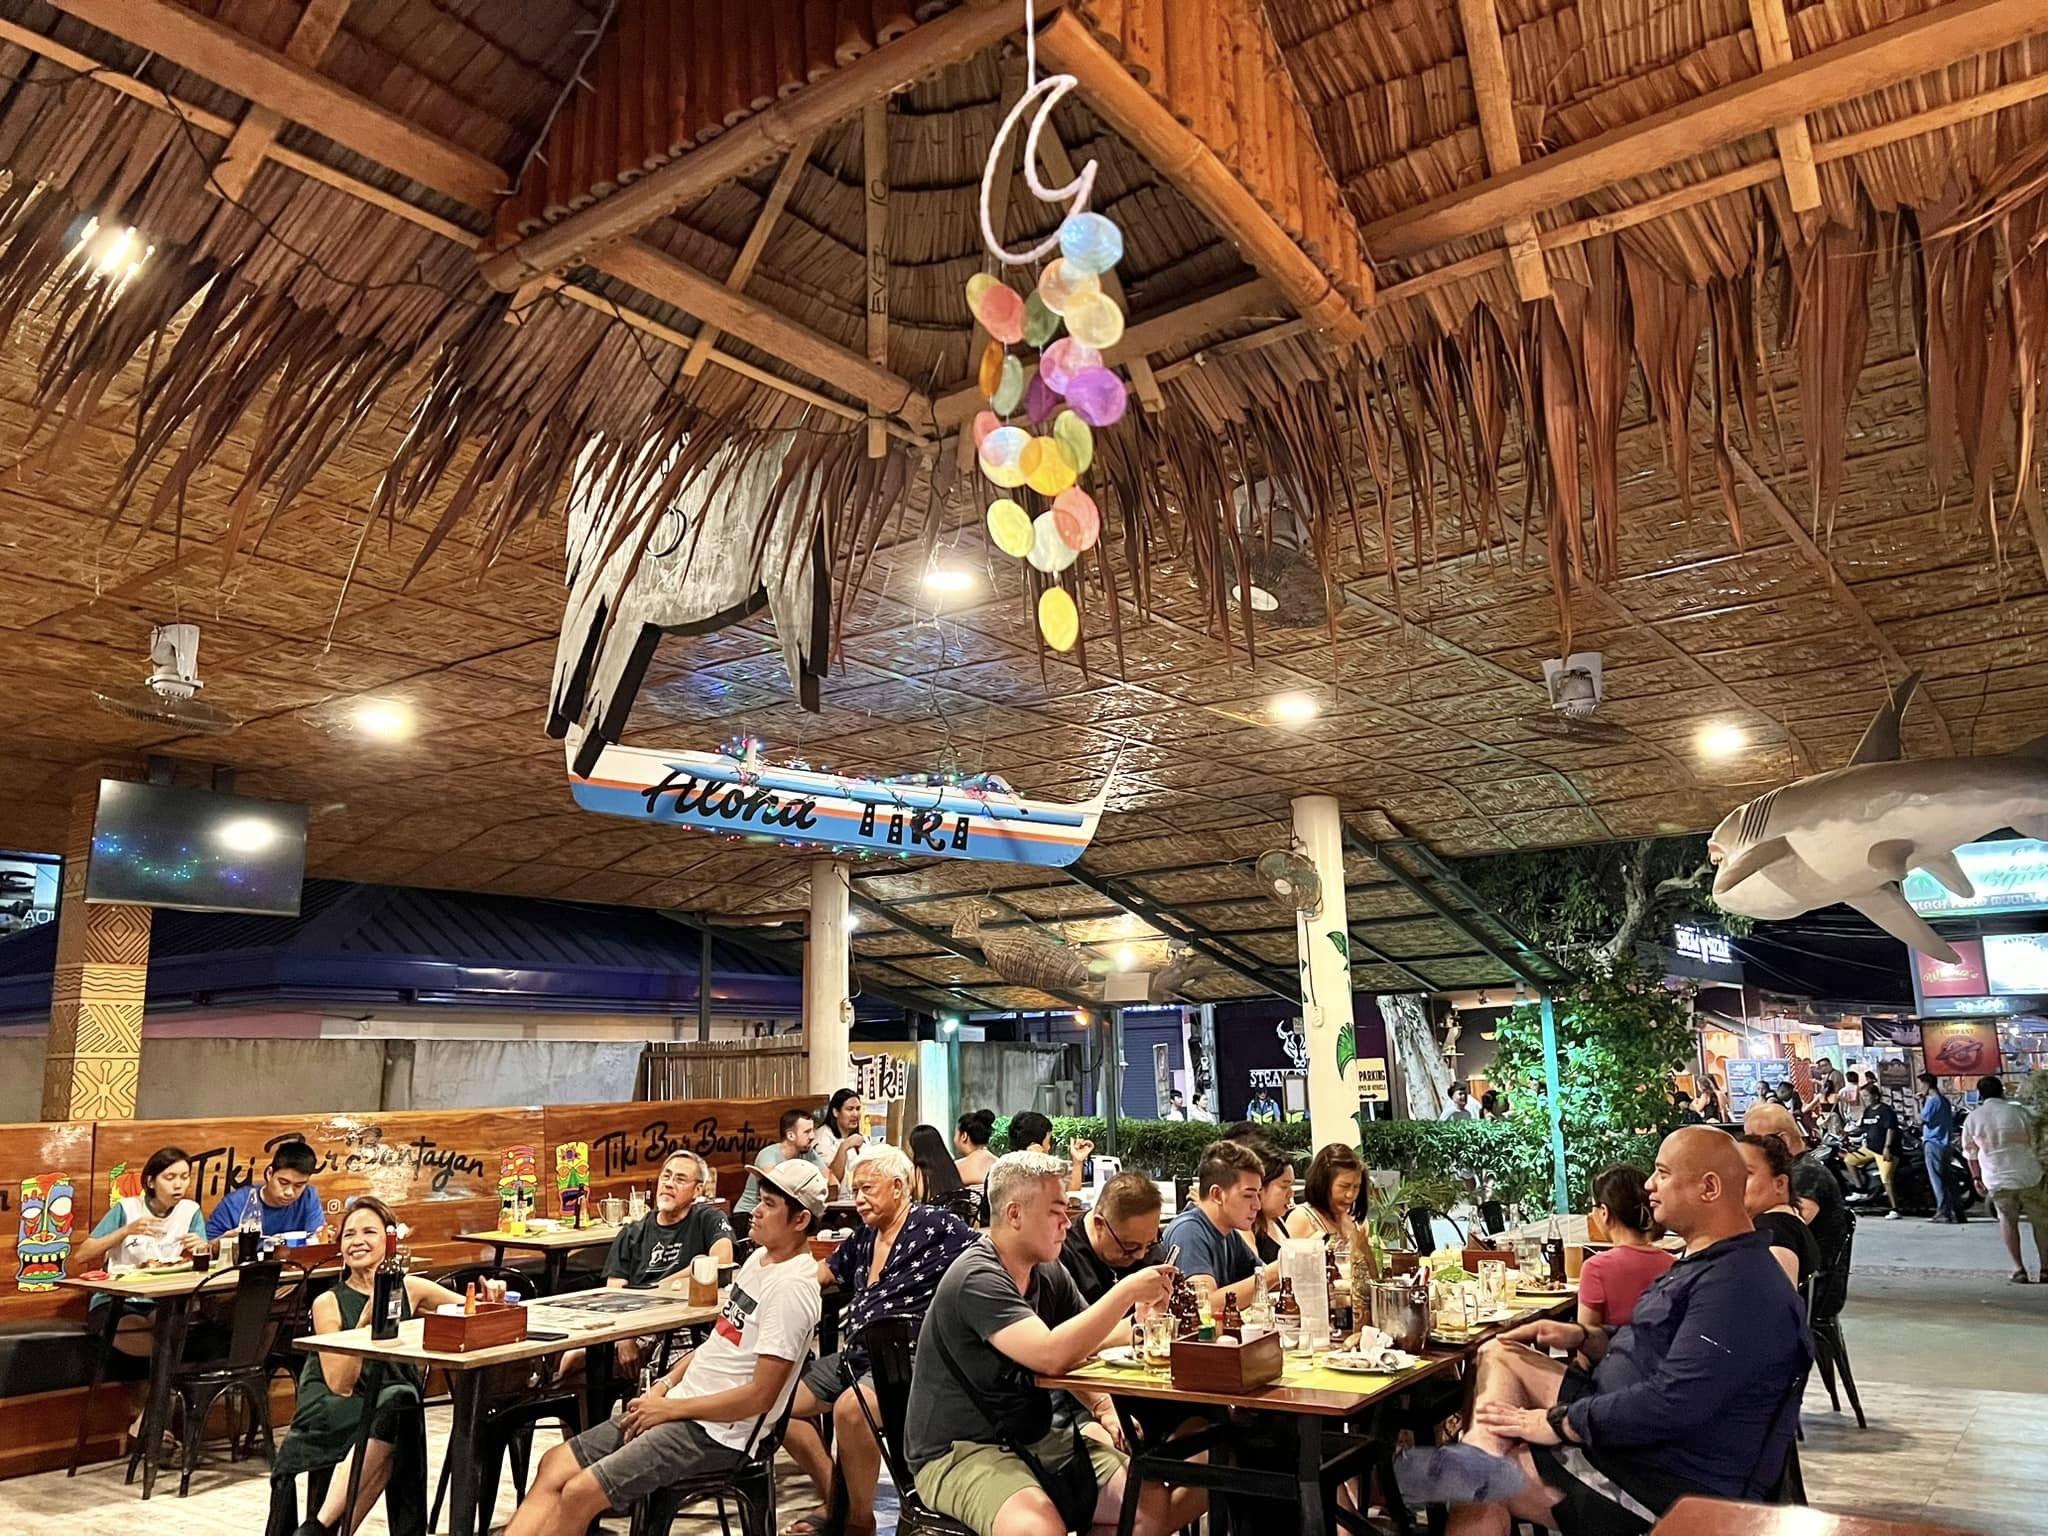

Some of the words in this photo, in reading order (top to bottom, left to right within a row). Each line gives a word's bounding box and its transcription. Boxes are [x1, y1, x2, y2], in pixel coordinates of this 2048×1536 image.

[642, 770, 817, 830] Aloha
[849, 1051, 906, 1101] Tiki
[1358, 1069, 1386, 1083] PARKING
[188, 1146, 255, 1202] Tiki
[593, 1130, 639, 1178] Tiki
